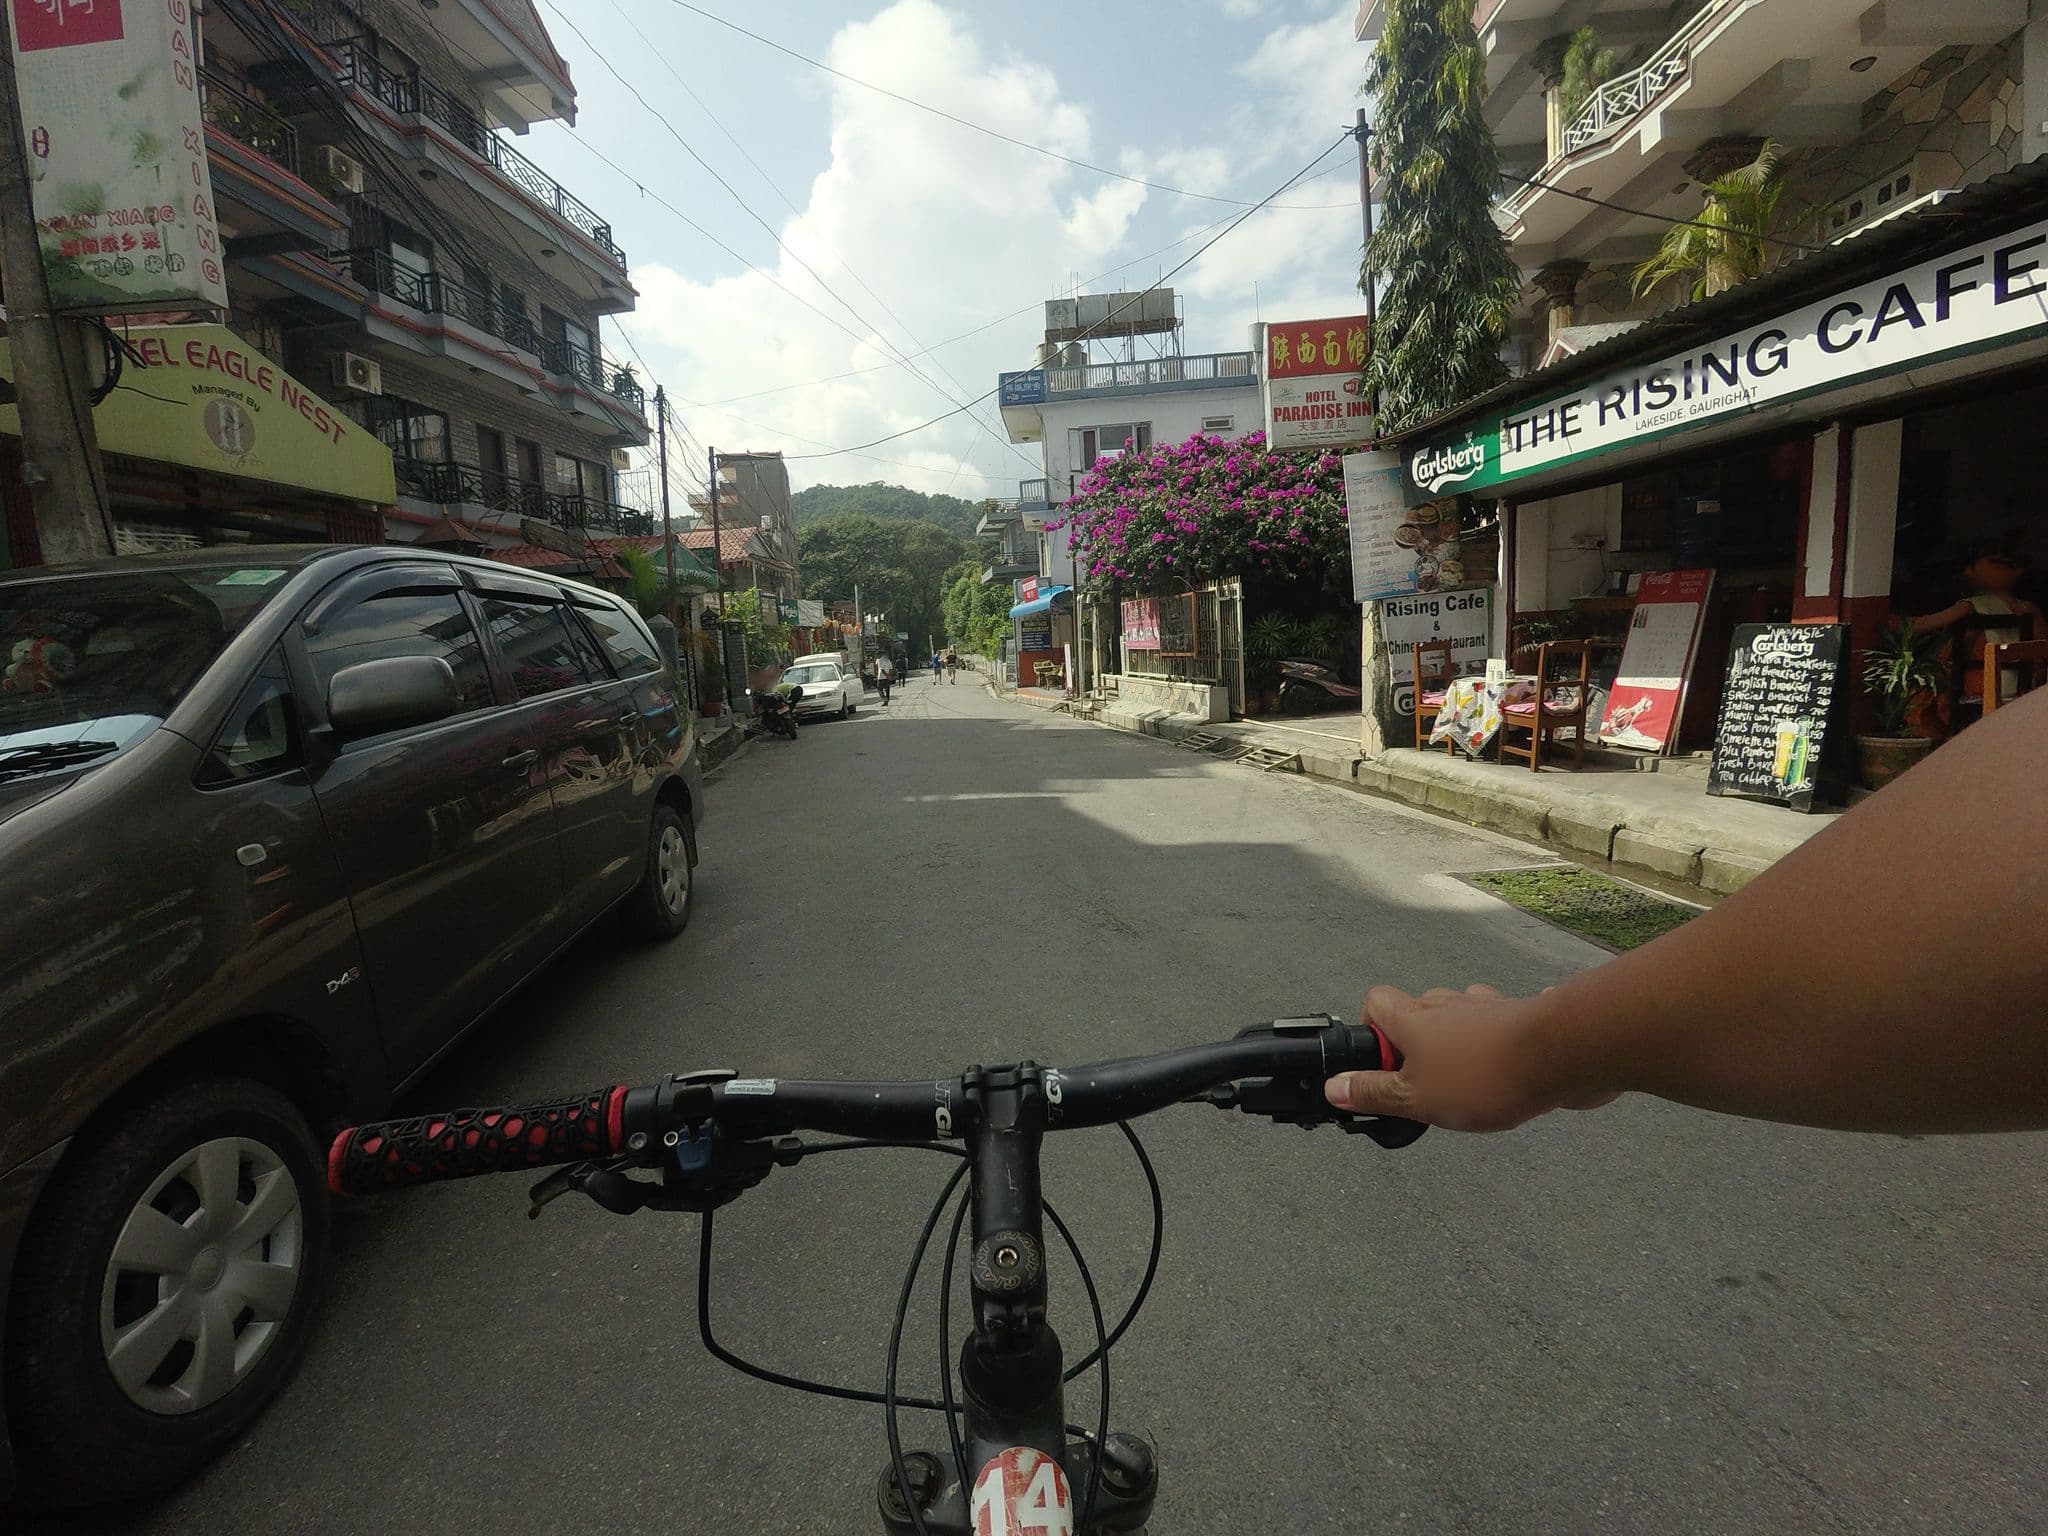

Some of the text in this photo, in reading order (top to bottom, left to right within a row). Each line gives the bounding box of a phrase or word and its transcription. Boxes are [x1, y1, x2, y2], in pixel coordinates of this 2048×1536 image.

[165, 0, 221, 285] UAN XIANG
[107, 205, 176, 226] XIANG
[1508, 234, 2048, 454] THE RISING CAFE
[126, 338, 347, 446] TEL EAGLE NEST
[192, 384, 262, 413] Managed By
[1305, 390, 1337, 403] HOTEL
[1273, 401, 1372, 422] PARADISE INN
[1635, 386, 1758, 432] LAKESIDE, GAURIGHAT
[1412, 443, 1485, 489] Carlsberg
[1386, 594, 1485, 618] Rising Cafe
[1433, 621, 1441, 631] &
[1388, 640, 1415, 655] Chine
[1752, 634, 1815, 656] Carlsberg
[1731, 677, 1767, 692] English
[1717, 758, 1744, 771] Fresh
[1719, 771, 1735, 783] Tea
[975, 1463, 1066, 1536] 14
